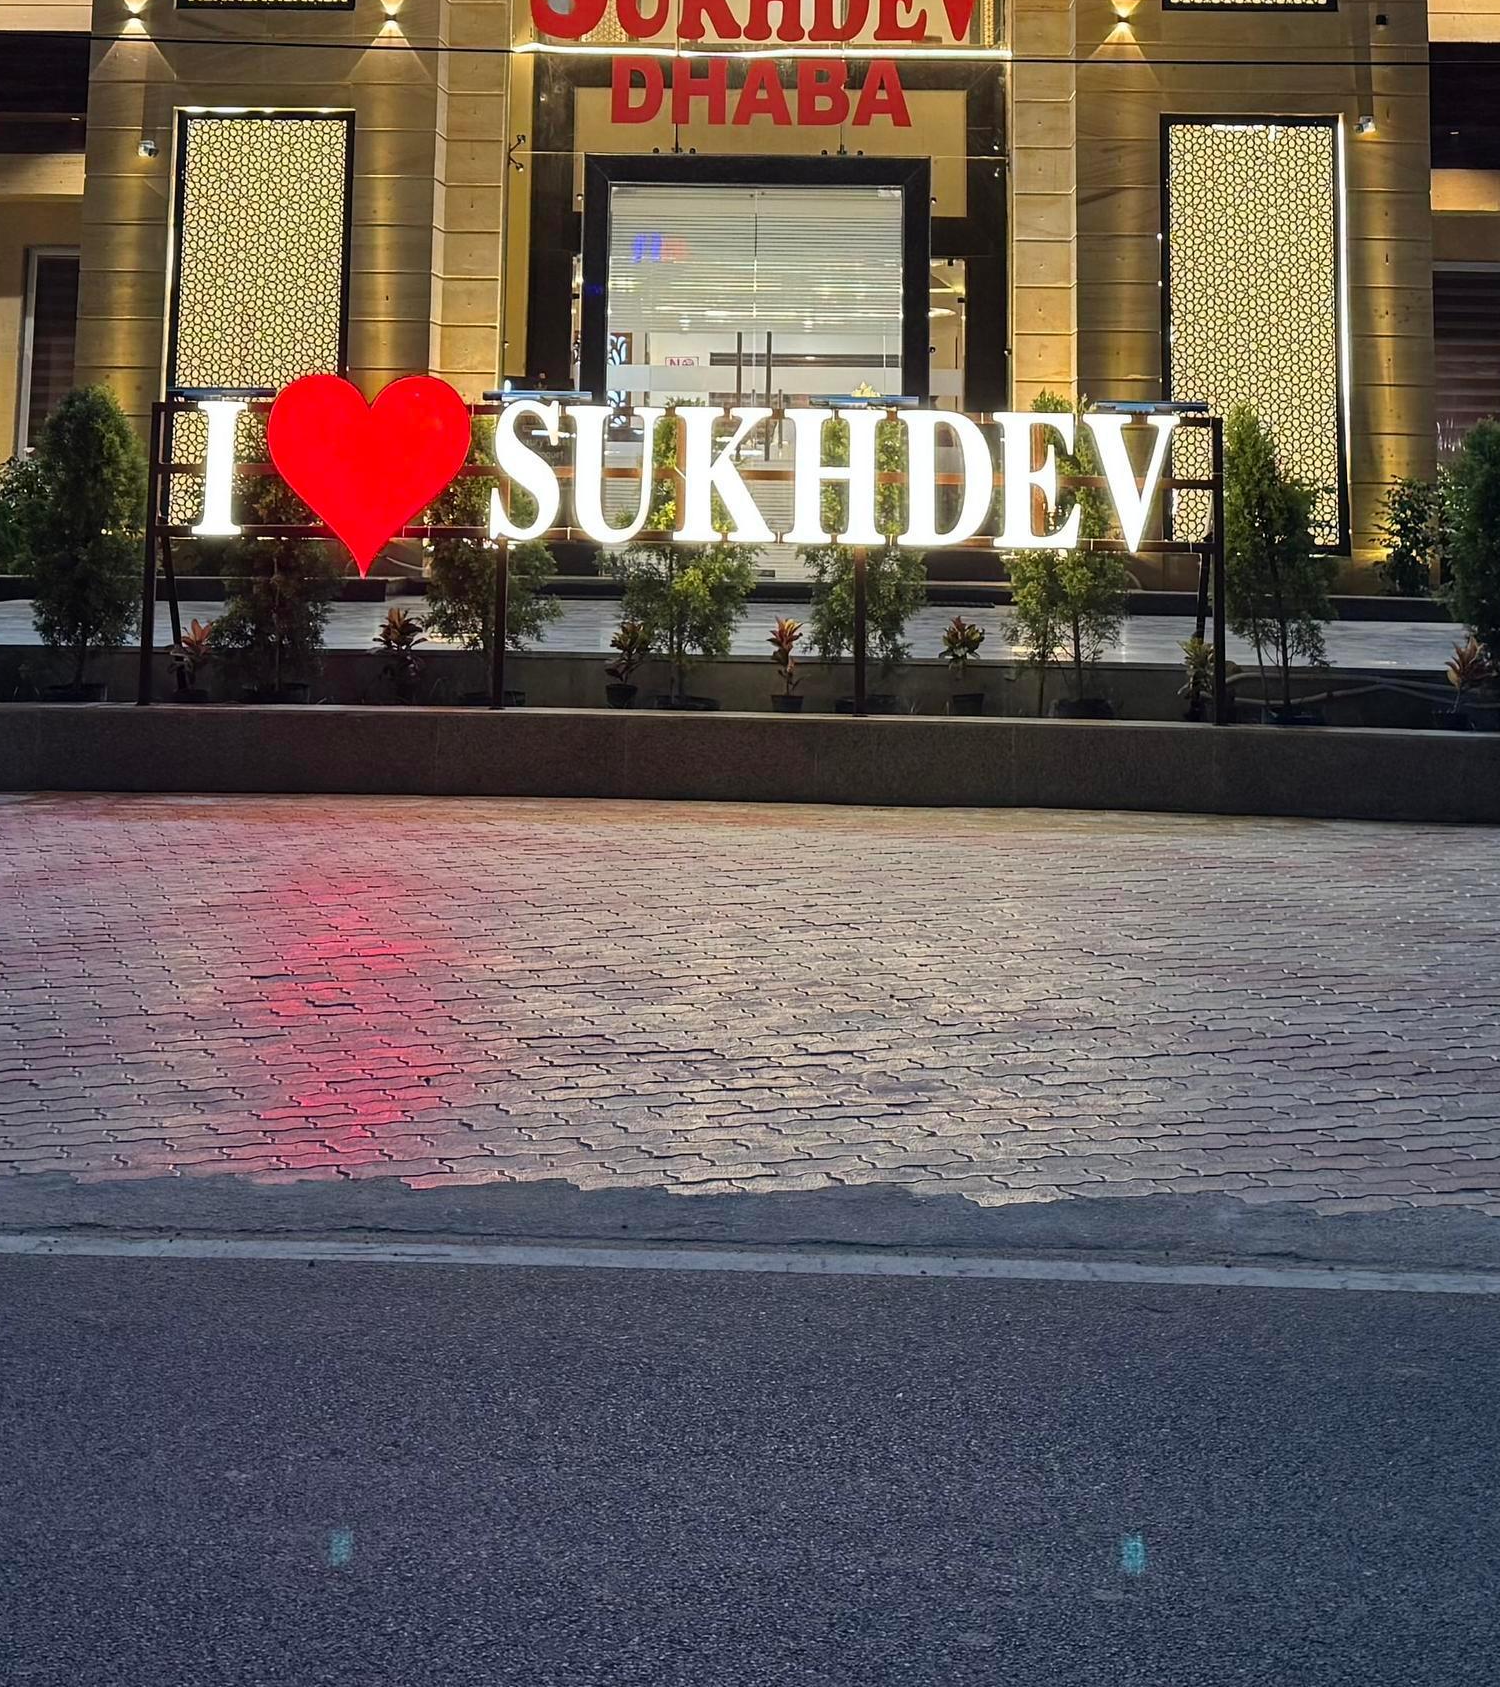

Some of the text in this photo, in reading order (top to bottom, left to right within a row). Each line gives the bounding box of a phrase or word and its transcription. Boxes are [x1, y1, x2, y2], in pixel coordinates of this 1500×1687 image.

[611, 57, 912, 127] DHABA
[191, 400, 1179, 553] I SUKHDEV
